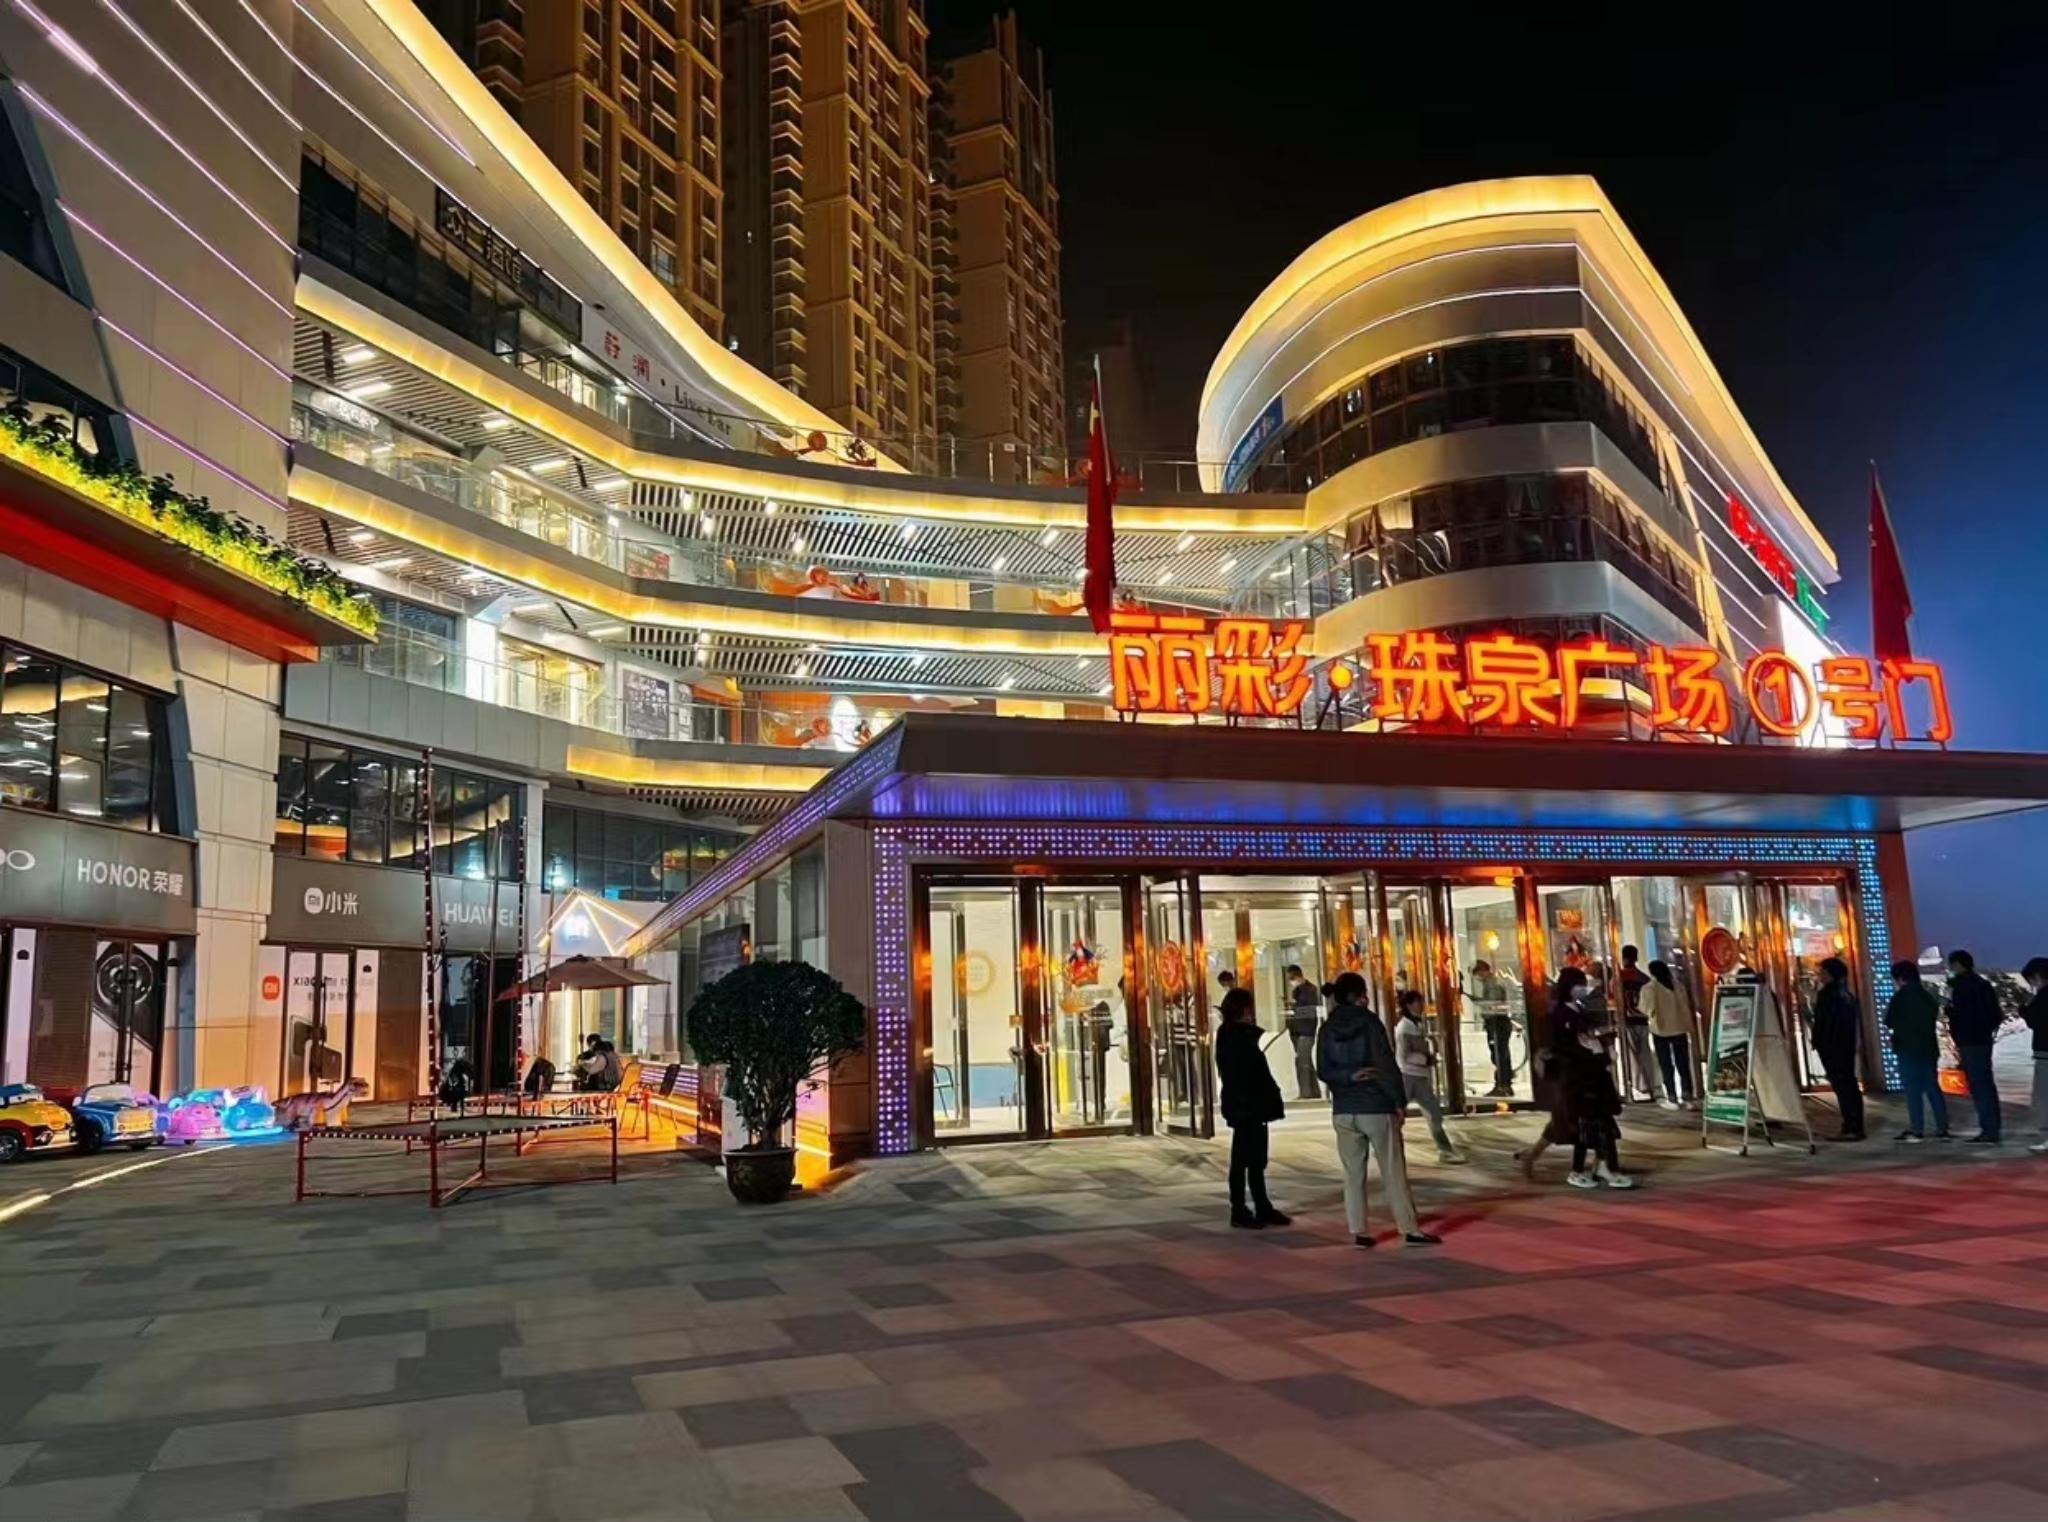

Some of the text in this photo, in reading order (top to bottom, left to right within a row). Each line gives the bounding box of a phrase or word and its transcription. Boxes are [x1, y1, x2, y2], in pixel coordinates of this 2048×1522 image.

[77, 858, 184, 896] HONOR 荣耀
[325, 890, 360, 916] 小米
[444, 902, 514, 927] HUAWEI
